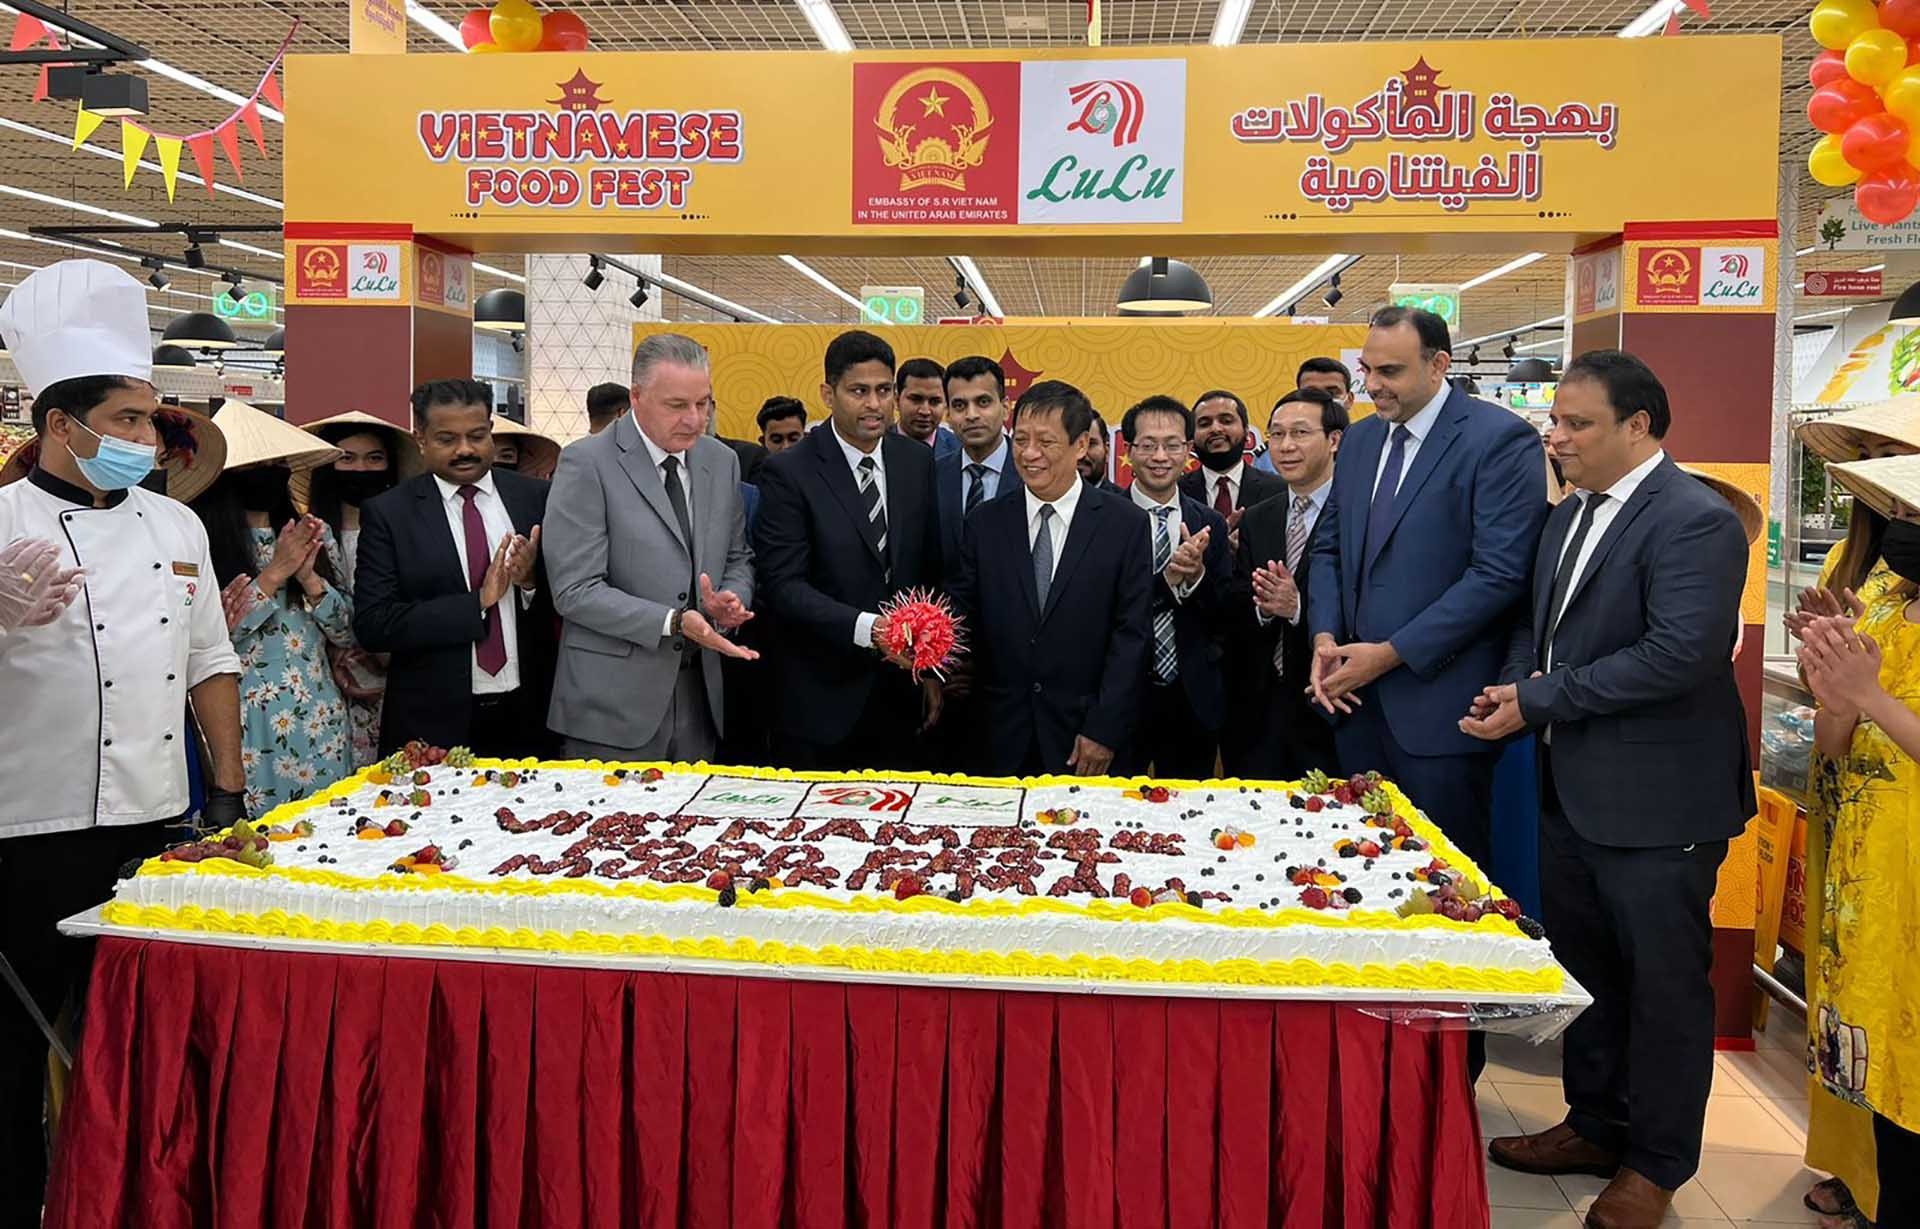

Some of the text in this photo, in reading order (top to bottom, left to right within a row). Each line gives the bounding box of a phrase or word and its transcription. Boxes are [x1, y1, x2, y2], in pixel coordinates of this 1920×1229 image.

[1232, 77, 1616, 151] بهجة المأكولات
[418, 111, 742, 162] VIETNAMESE
[467, 168, 690, 207] FOOD FEST
[1027, 154, 1175, 203] LuLu
[1300, 152, 1541, 208] الفيتنامية
[858, 210, 1008, 219] IN THE UNITED ARAB EMIRATES
[868, 197, 915, 206] EMBASSY
[917, 197, 931, 206] OF
[951, 197, 973, 206] VIET
[975, 197, 998, 206] NAM
[1851, 221, 1878, 231] Live
[1866, 233, 1920, 244] Fresh Fl
[351, 275, 398, 292] LuLu
[1703, 280, 1760, 297] LuLu
[493, 806, 1186, 857] VIETNAMESE
